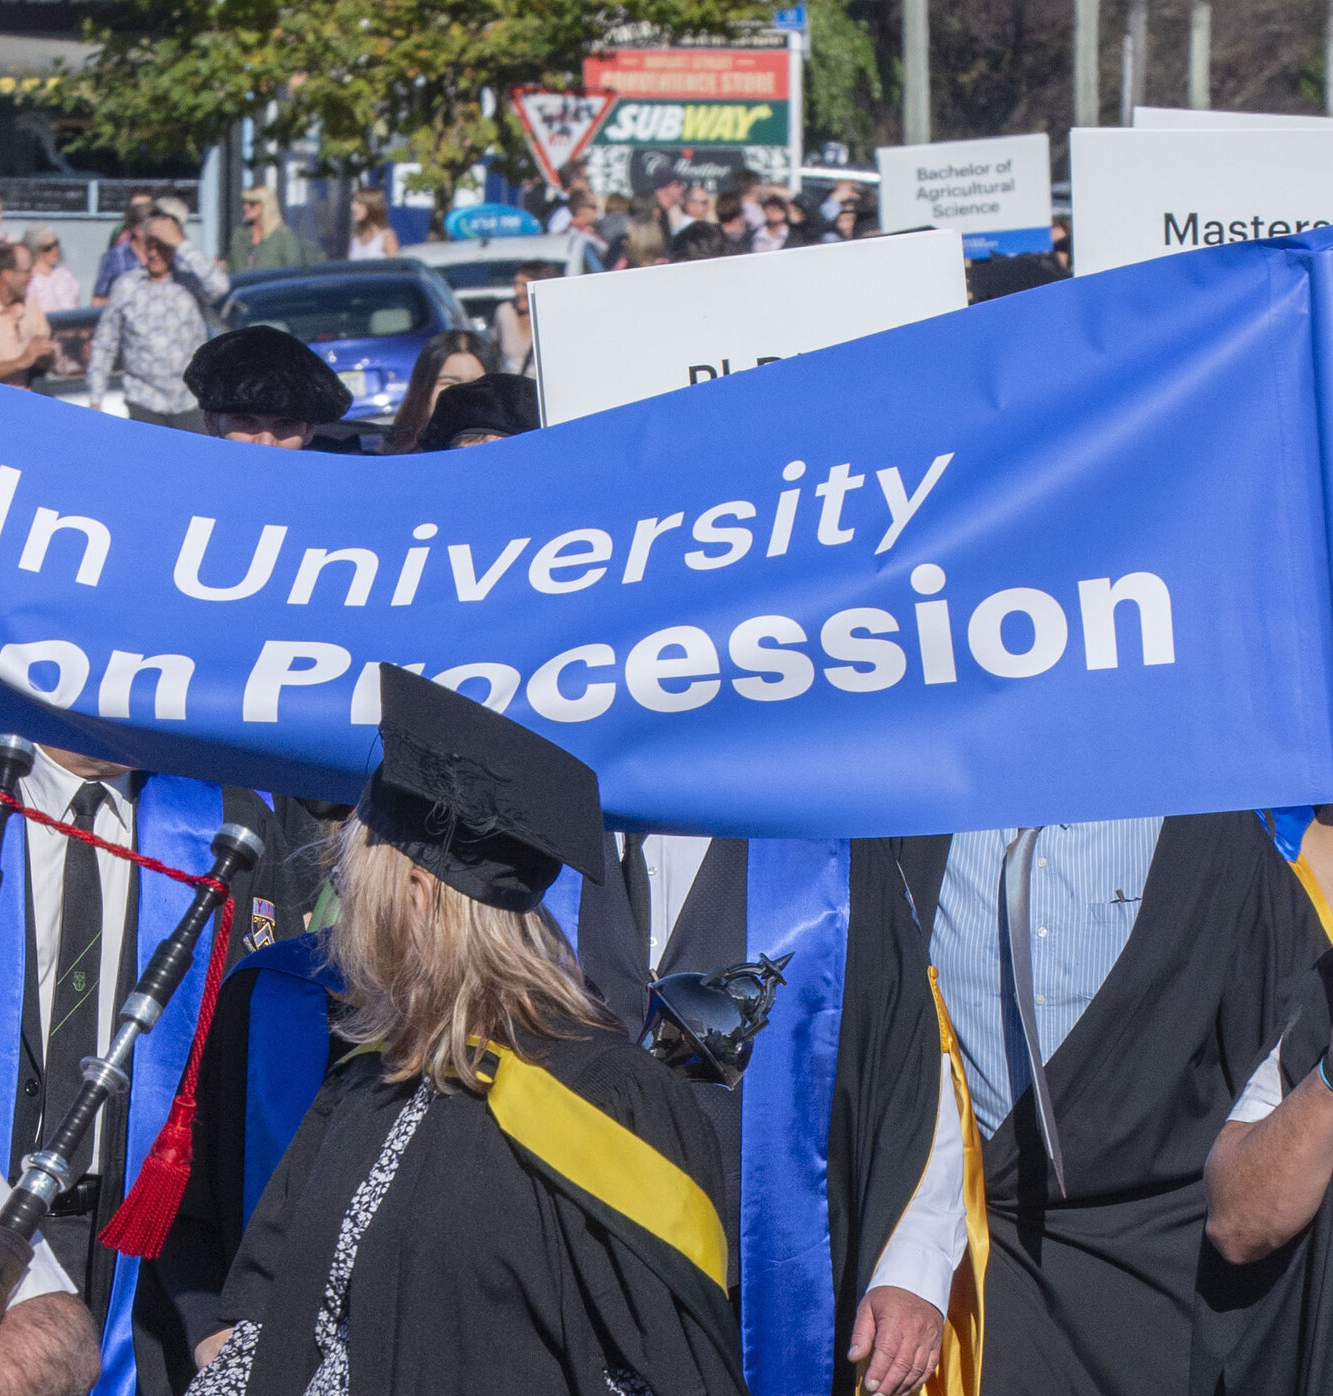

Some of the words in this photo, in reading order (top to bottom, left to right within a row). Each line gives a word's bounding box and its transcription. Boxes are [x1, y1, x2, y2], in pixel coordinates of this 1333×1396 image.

[604, 103, 773, 141] SUBWAY
[917, 163, 990, 182] Bachelor
[995, 158, 1013, 174] of
[916, 179, 1016, 202] Agricultural
[932, 201, 1001, 219] Science
[172, 453, 955, 606] University
